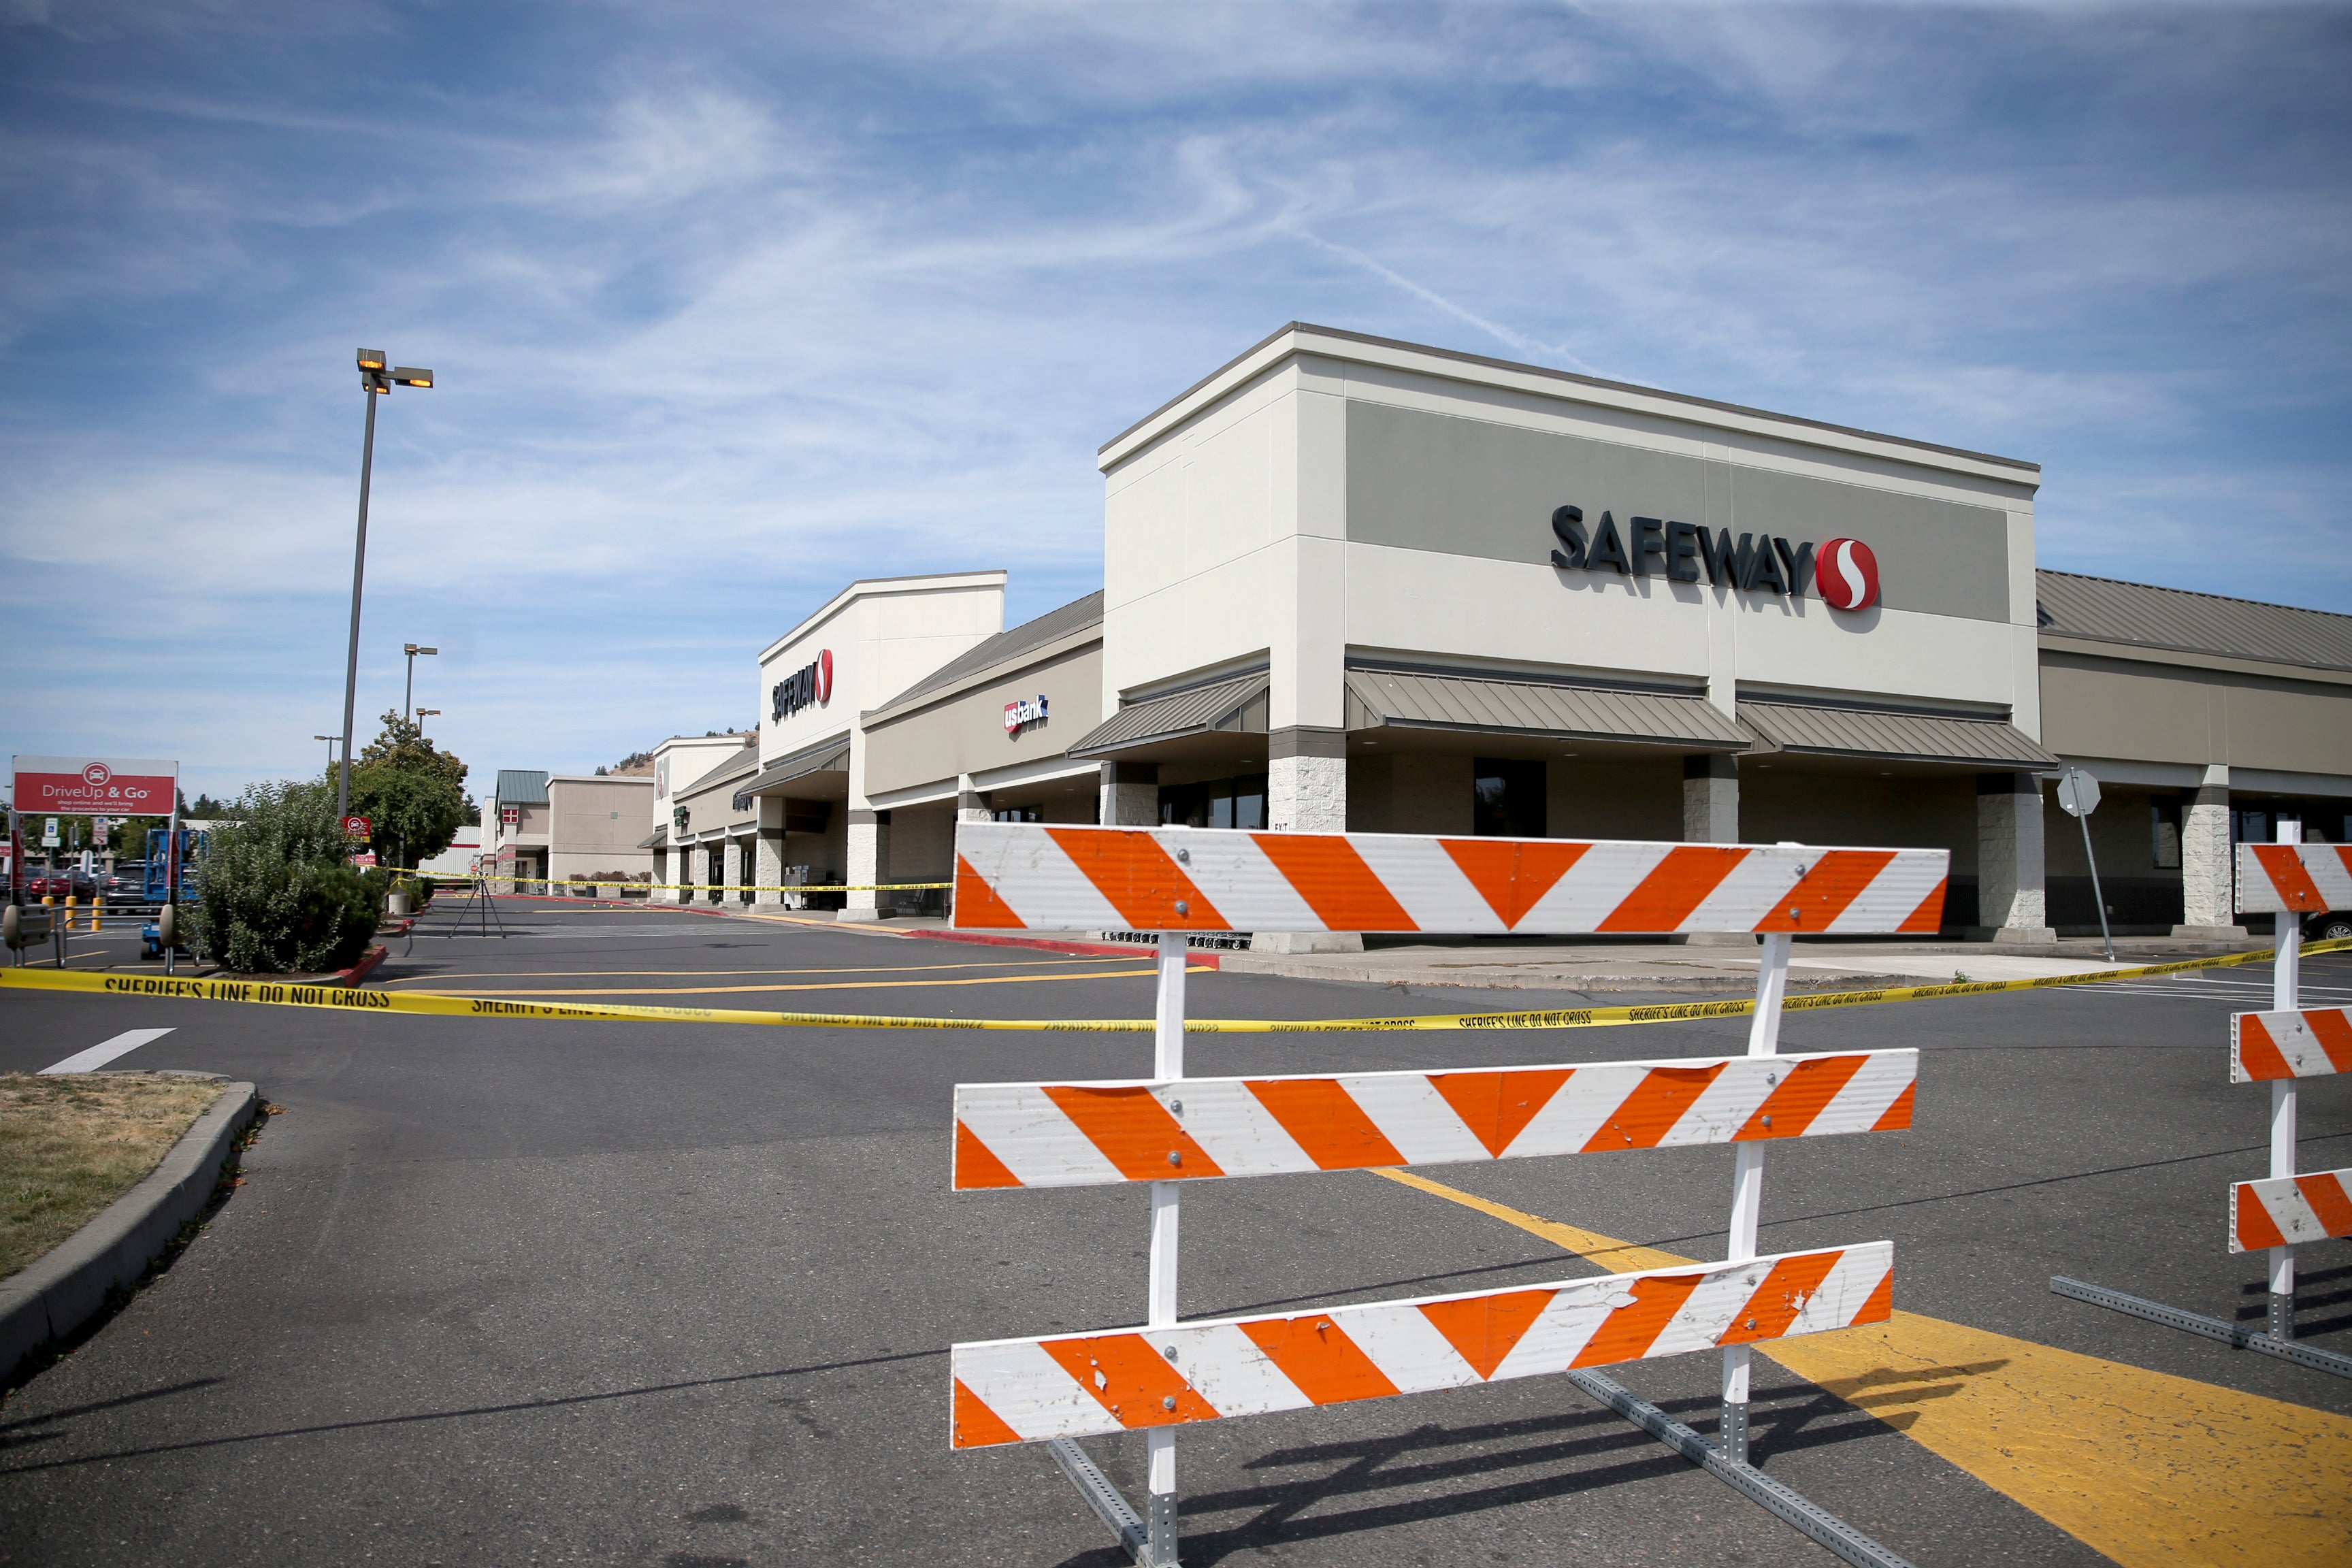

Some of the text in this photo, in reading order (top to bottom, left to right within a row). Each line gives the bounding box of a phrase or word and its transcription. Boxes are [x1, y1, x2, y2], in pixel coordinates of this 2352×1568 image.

[1551, 505, 1814, 595] SAFEWAY
[772, 662, 816, 721] SAFEWAY
[42, 785, 104, 800] DriveUp
[108, 787, 120, 798] &
[105, 978, 203, 998] SHERIFF'S
[259, 985, 284, 1002] DO
[291, 987, 327, 1004] NOT
[332, 990, 391, 1008] CROSS
[1815, 994, 1835, 1007] LINE
[1833, 994, 1846, 1004] DO
[1845, 992, 1863, 1004] NOT
[1859, 990, 1886, 1002] CROSS
[1459, 1011, 1592, 1029] SHERIFF'S LINE DO NOT CROSS
[1629, 1001, 1748, 1022] SHERIFF'S LINE DO NOT CROSS
